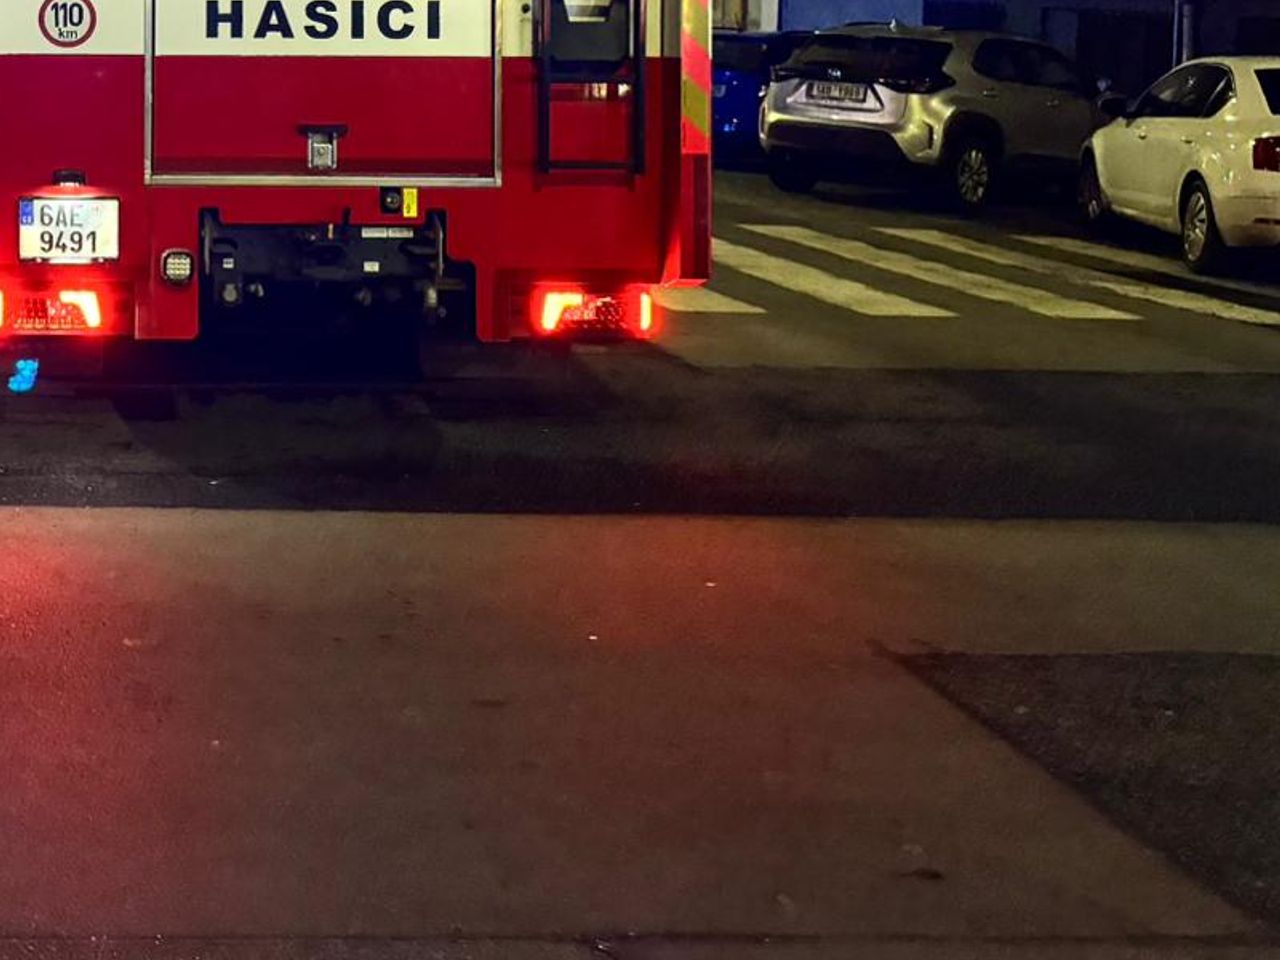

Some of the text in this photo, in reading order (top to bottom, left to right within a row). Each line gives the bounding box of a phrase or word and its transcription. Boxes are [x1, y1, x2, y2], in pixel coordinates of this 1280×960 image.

[51, 2, 85, 28] 110
[58, 28, 79, 39] km
[40, 204, 84, 228] 6AE
[39, 230, 97, 254] 9491
